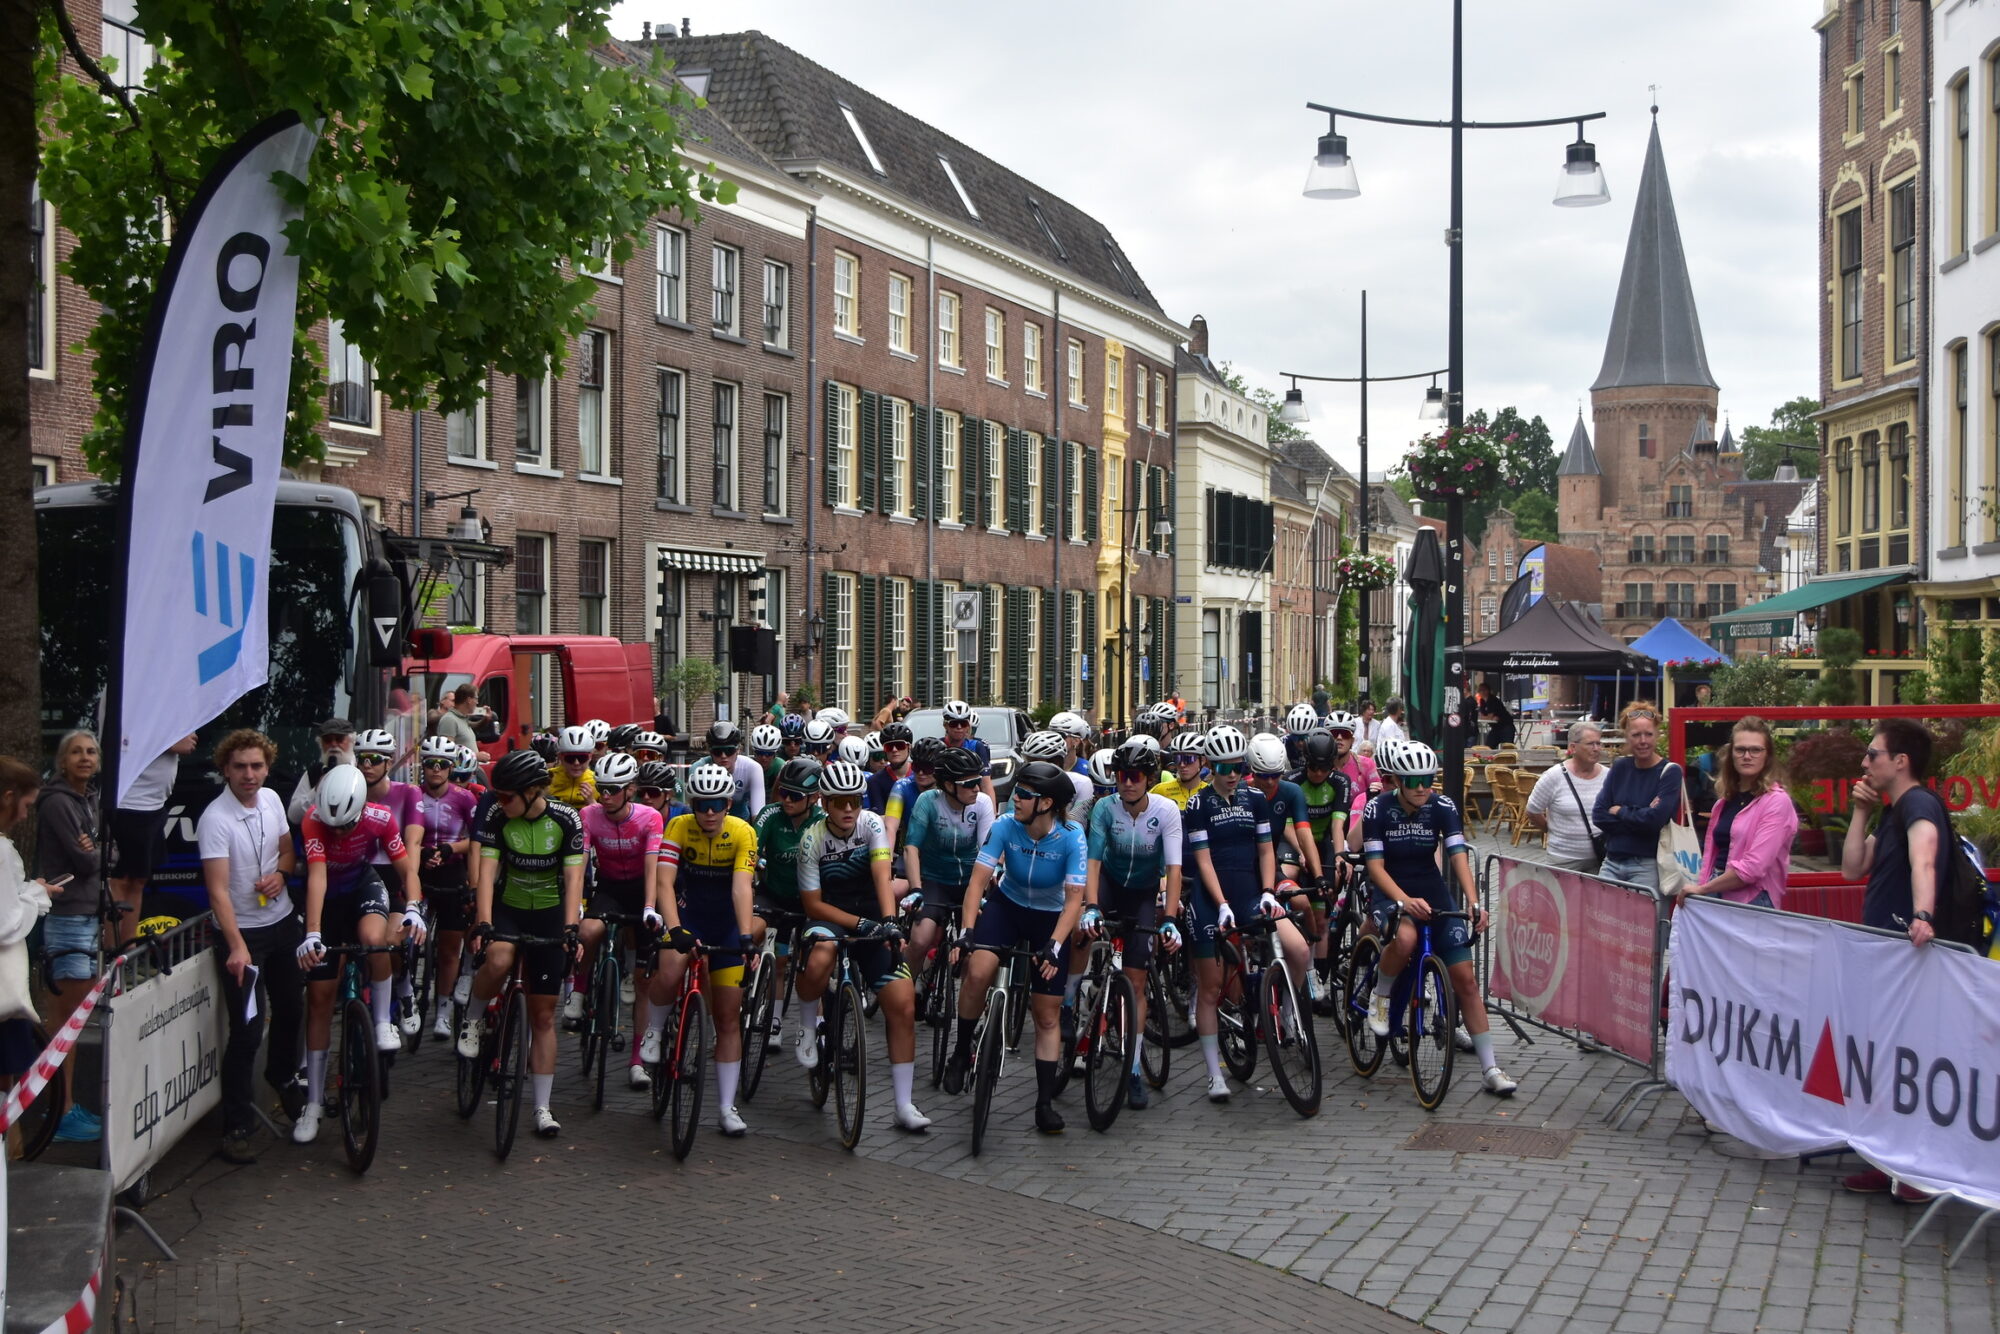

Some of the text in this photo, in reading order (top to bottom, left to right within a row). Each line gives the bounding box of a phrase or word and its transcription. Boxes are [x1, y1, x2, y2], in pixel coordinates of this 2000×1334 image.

[202, 231, 271, 505] VIRO
[1520, 657, 1559, 668] zutphen
[1221, 805, 1244, 813] FLYING
[549, 801, 583, 830] velodroom
[756, 805, 781, 828] DYNAMIC
[1210, 812, 1254, 822] FREELANCERS
[1385, 829, 1433, 837] FREELANCERS
[1077, 833, 1088, 871] VIRO
[152, 872, 199, 881] BERKHOF
